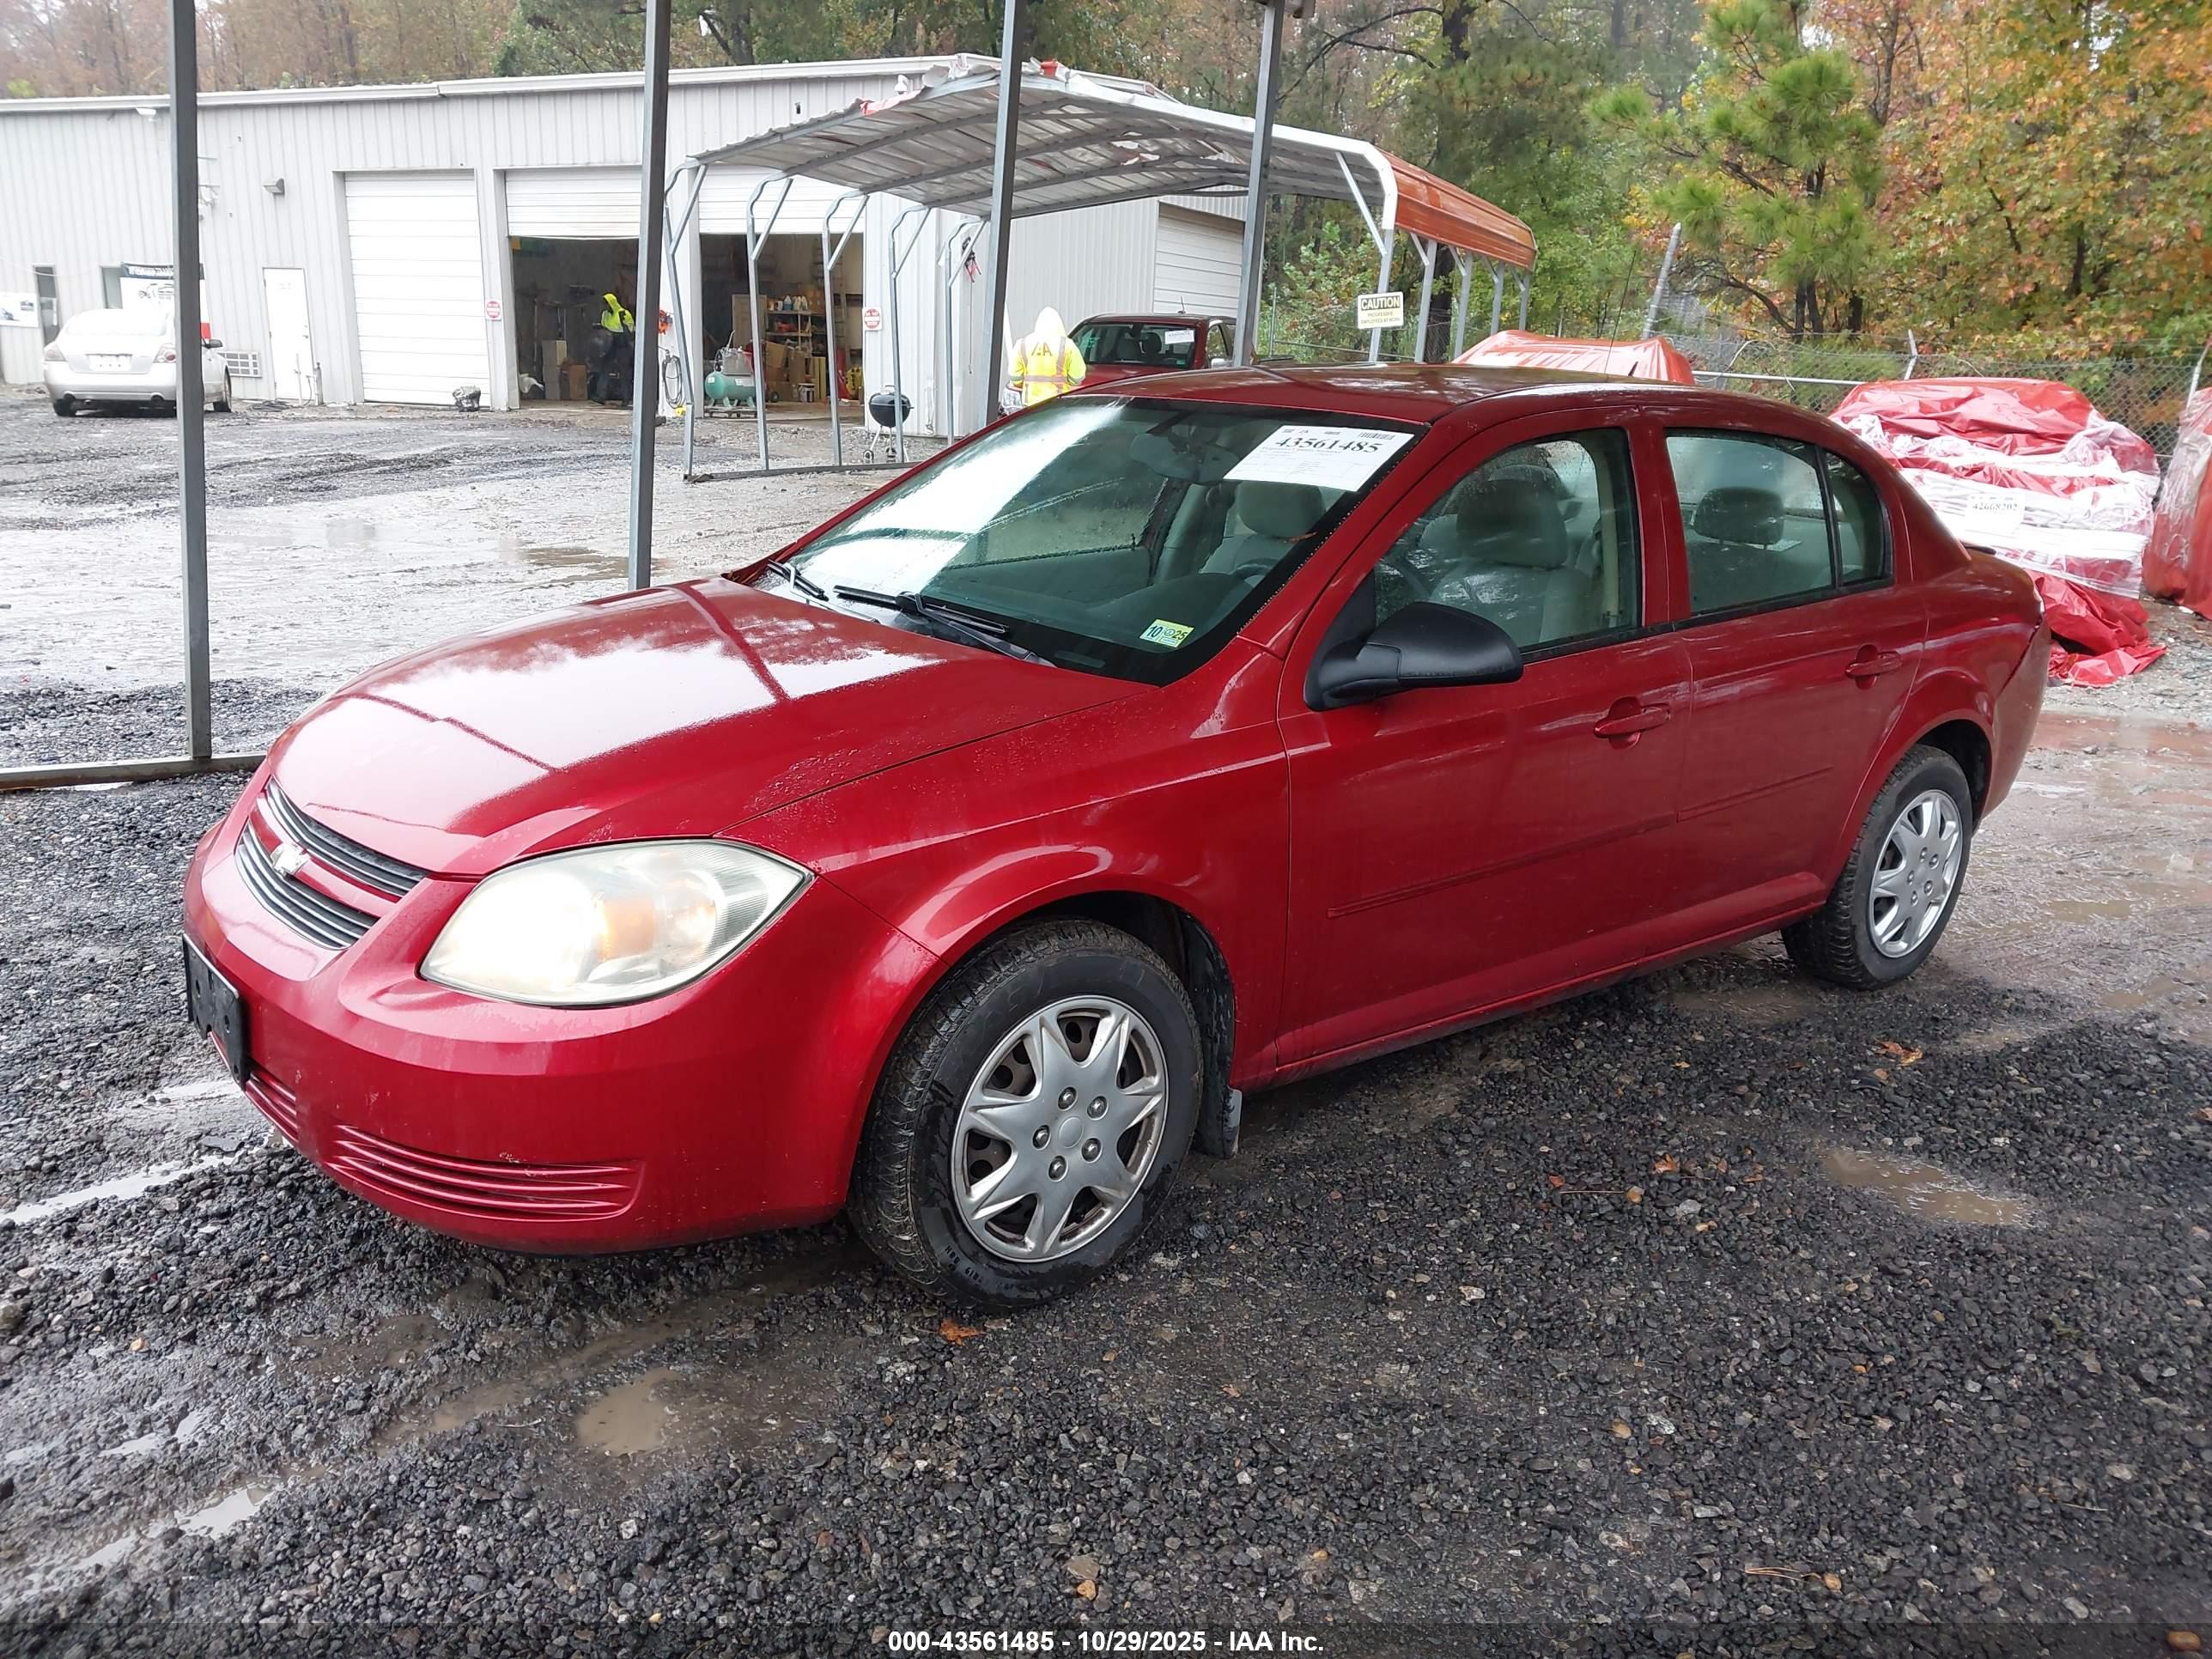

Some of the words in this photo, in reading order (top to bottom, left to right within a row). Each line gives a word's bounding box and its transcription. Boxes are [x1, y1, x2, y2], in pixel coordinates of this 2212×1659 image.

[1361, 296, 1400, 310] CAUTION
[1275, 437, 1384, 453] 43561485
[1146, 625, 1164, 638] 10
[1172, 630, 1188, 641] 25
